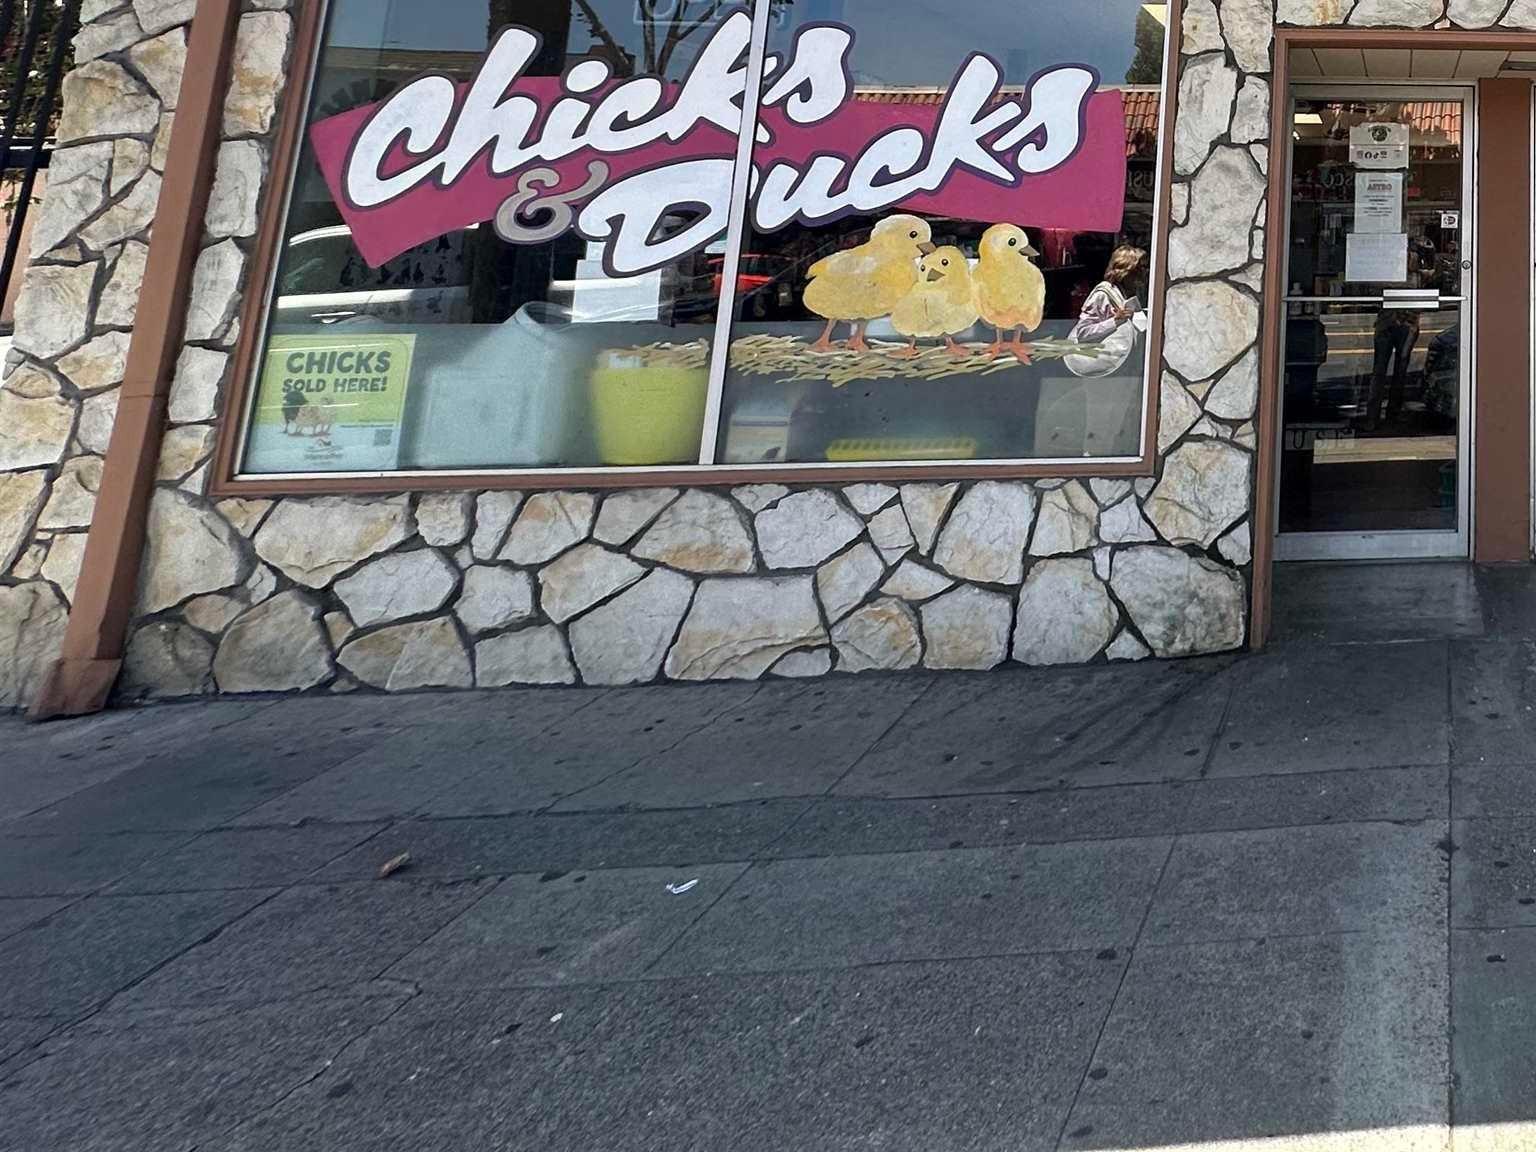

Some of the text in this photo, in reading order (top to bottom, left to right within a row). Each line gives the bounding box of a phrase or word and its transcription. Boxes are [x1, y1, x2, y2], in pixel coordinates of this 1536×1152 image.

[341, 10, 853, 210] Chicks
[495, 52, 1095, 273] & Ducks
[282, 376, 388, 393] SOLD HERE!
[286, 351, 392, 374] CHICKS
